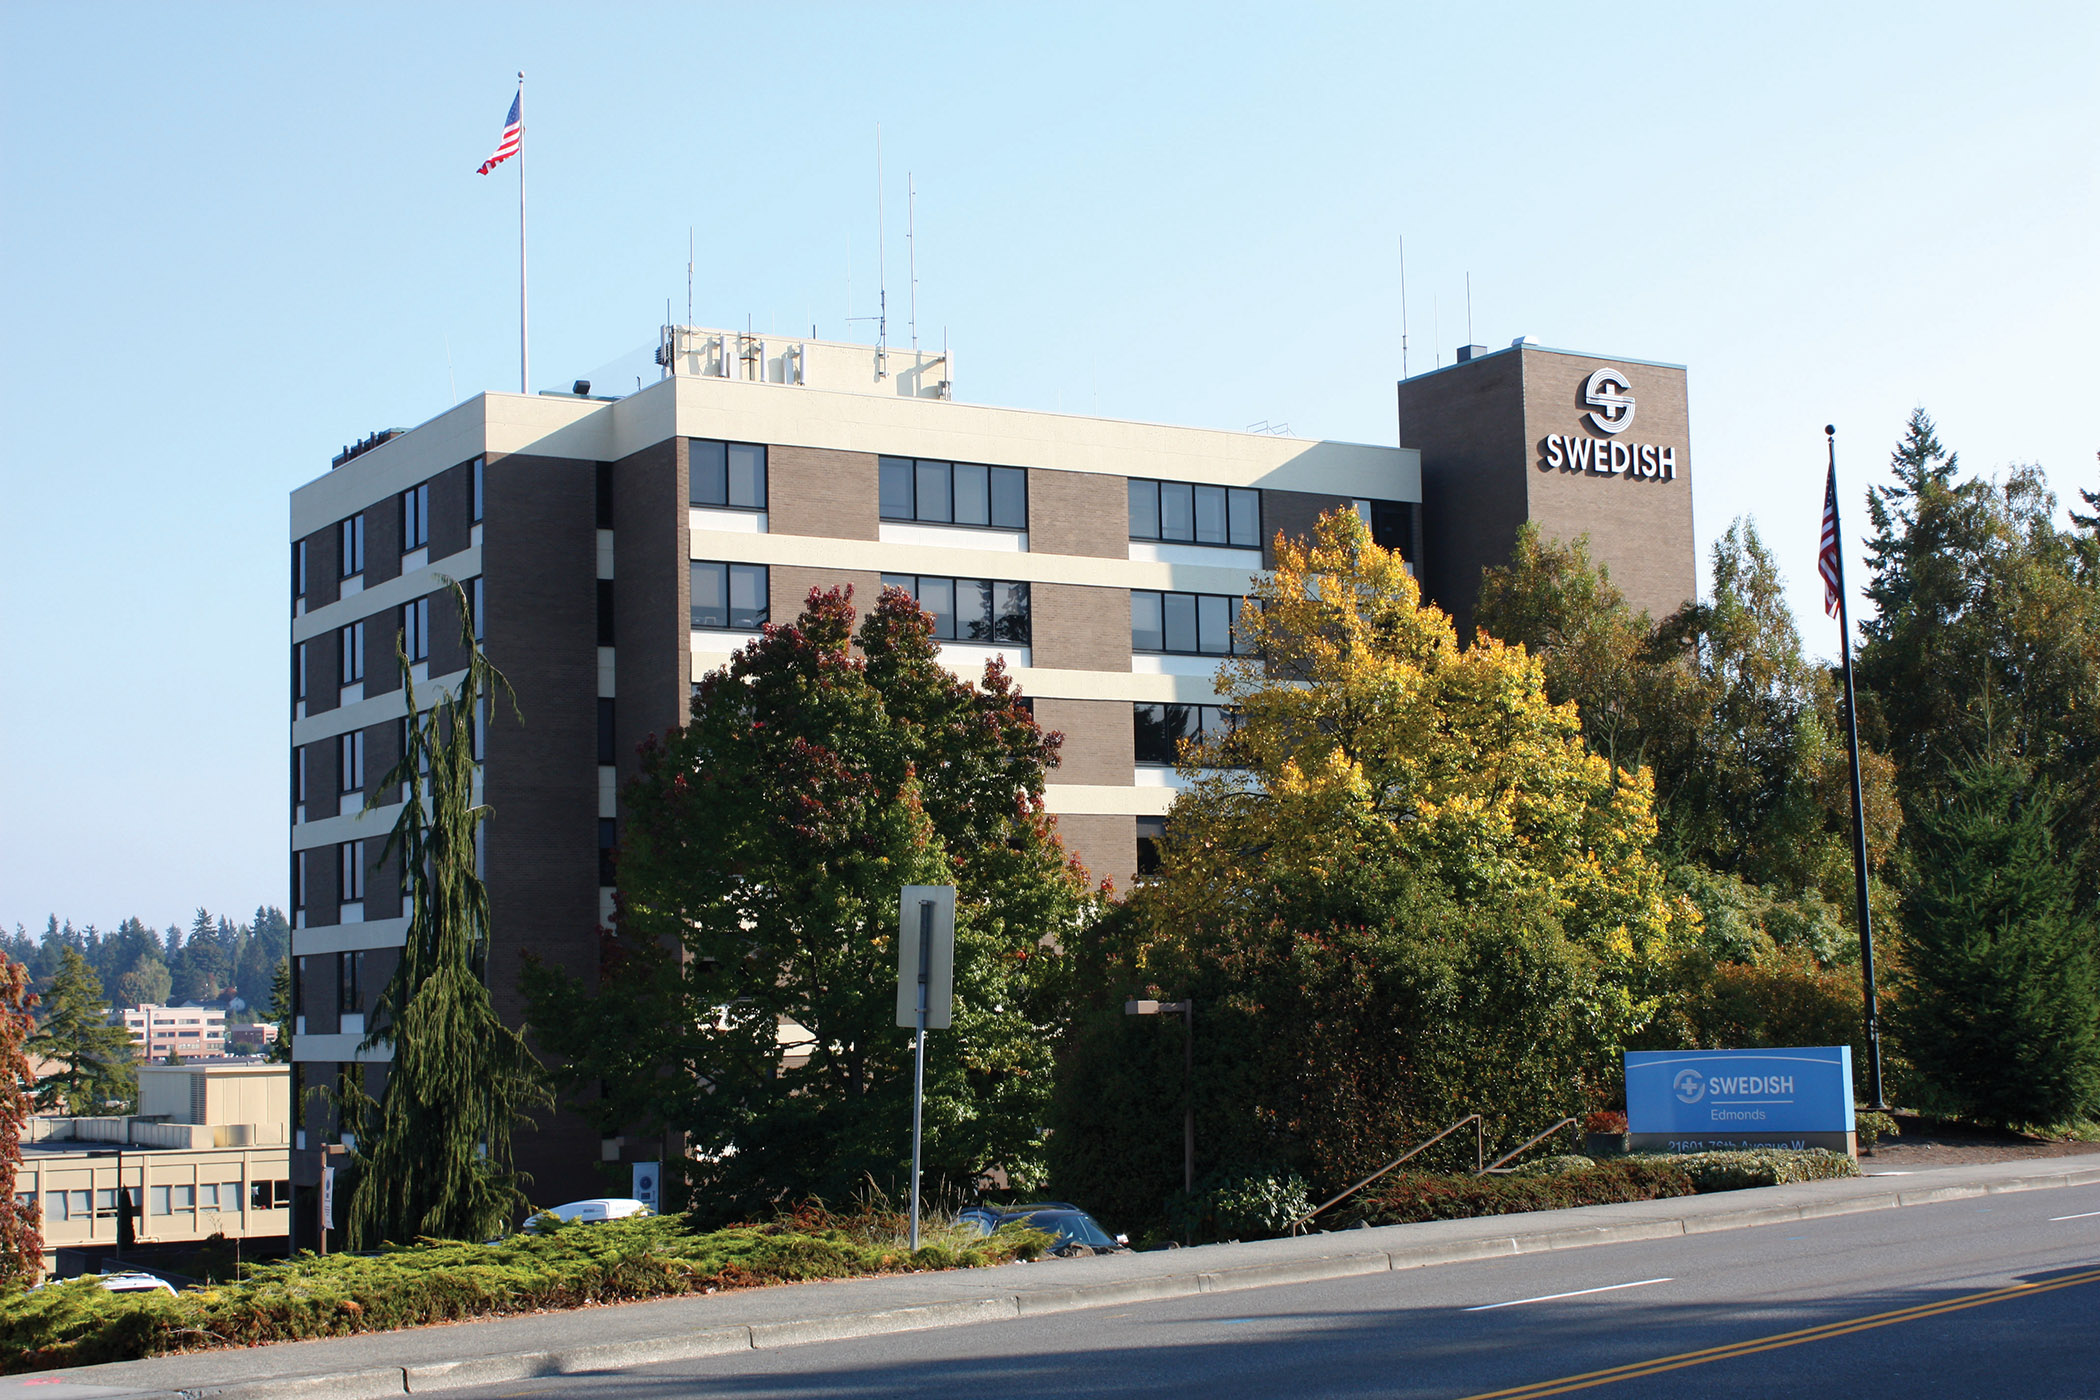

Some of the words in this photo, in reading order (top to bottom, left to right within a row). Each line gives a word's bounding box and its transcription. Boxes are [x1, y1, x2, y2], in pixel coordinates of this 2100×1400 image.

[1546, 433, 1677, 479] SWEDISH
[1709, 1076, 1794, 1095] SWEDISH
[1711, 1108, 1766, 1121] Edmonds
[1668, 1140, 1703, 1152] 21601
[1791, 1140, 1805, 1151] W
